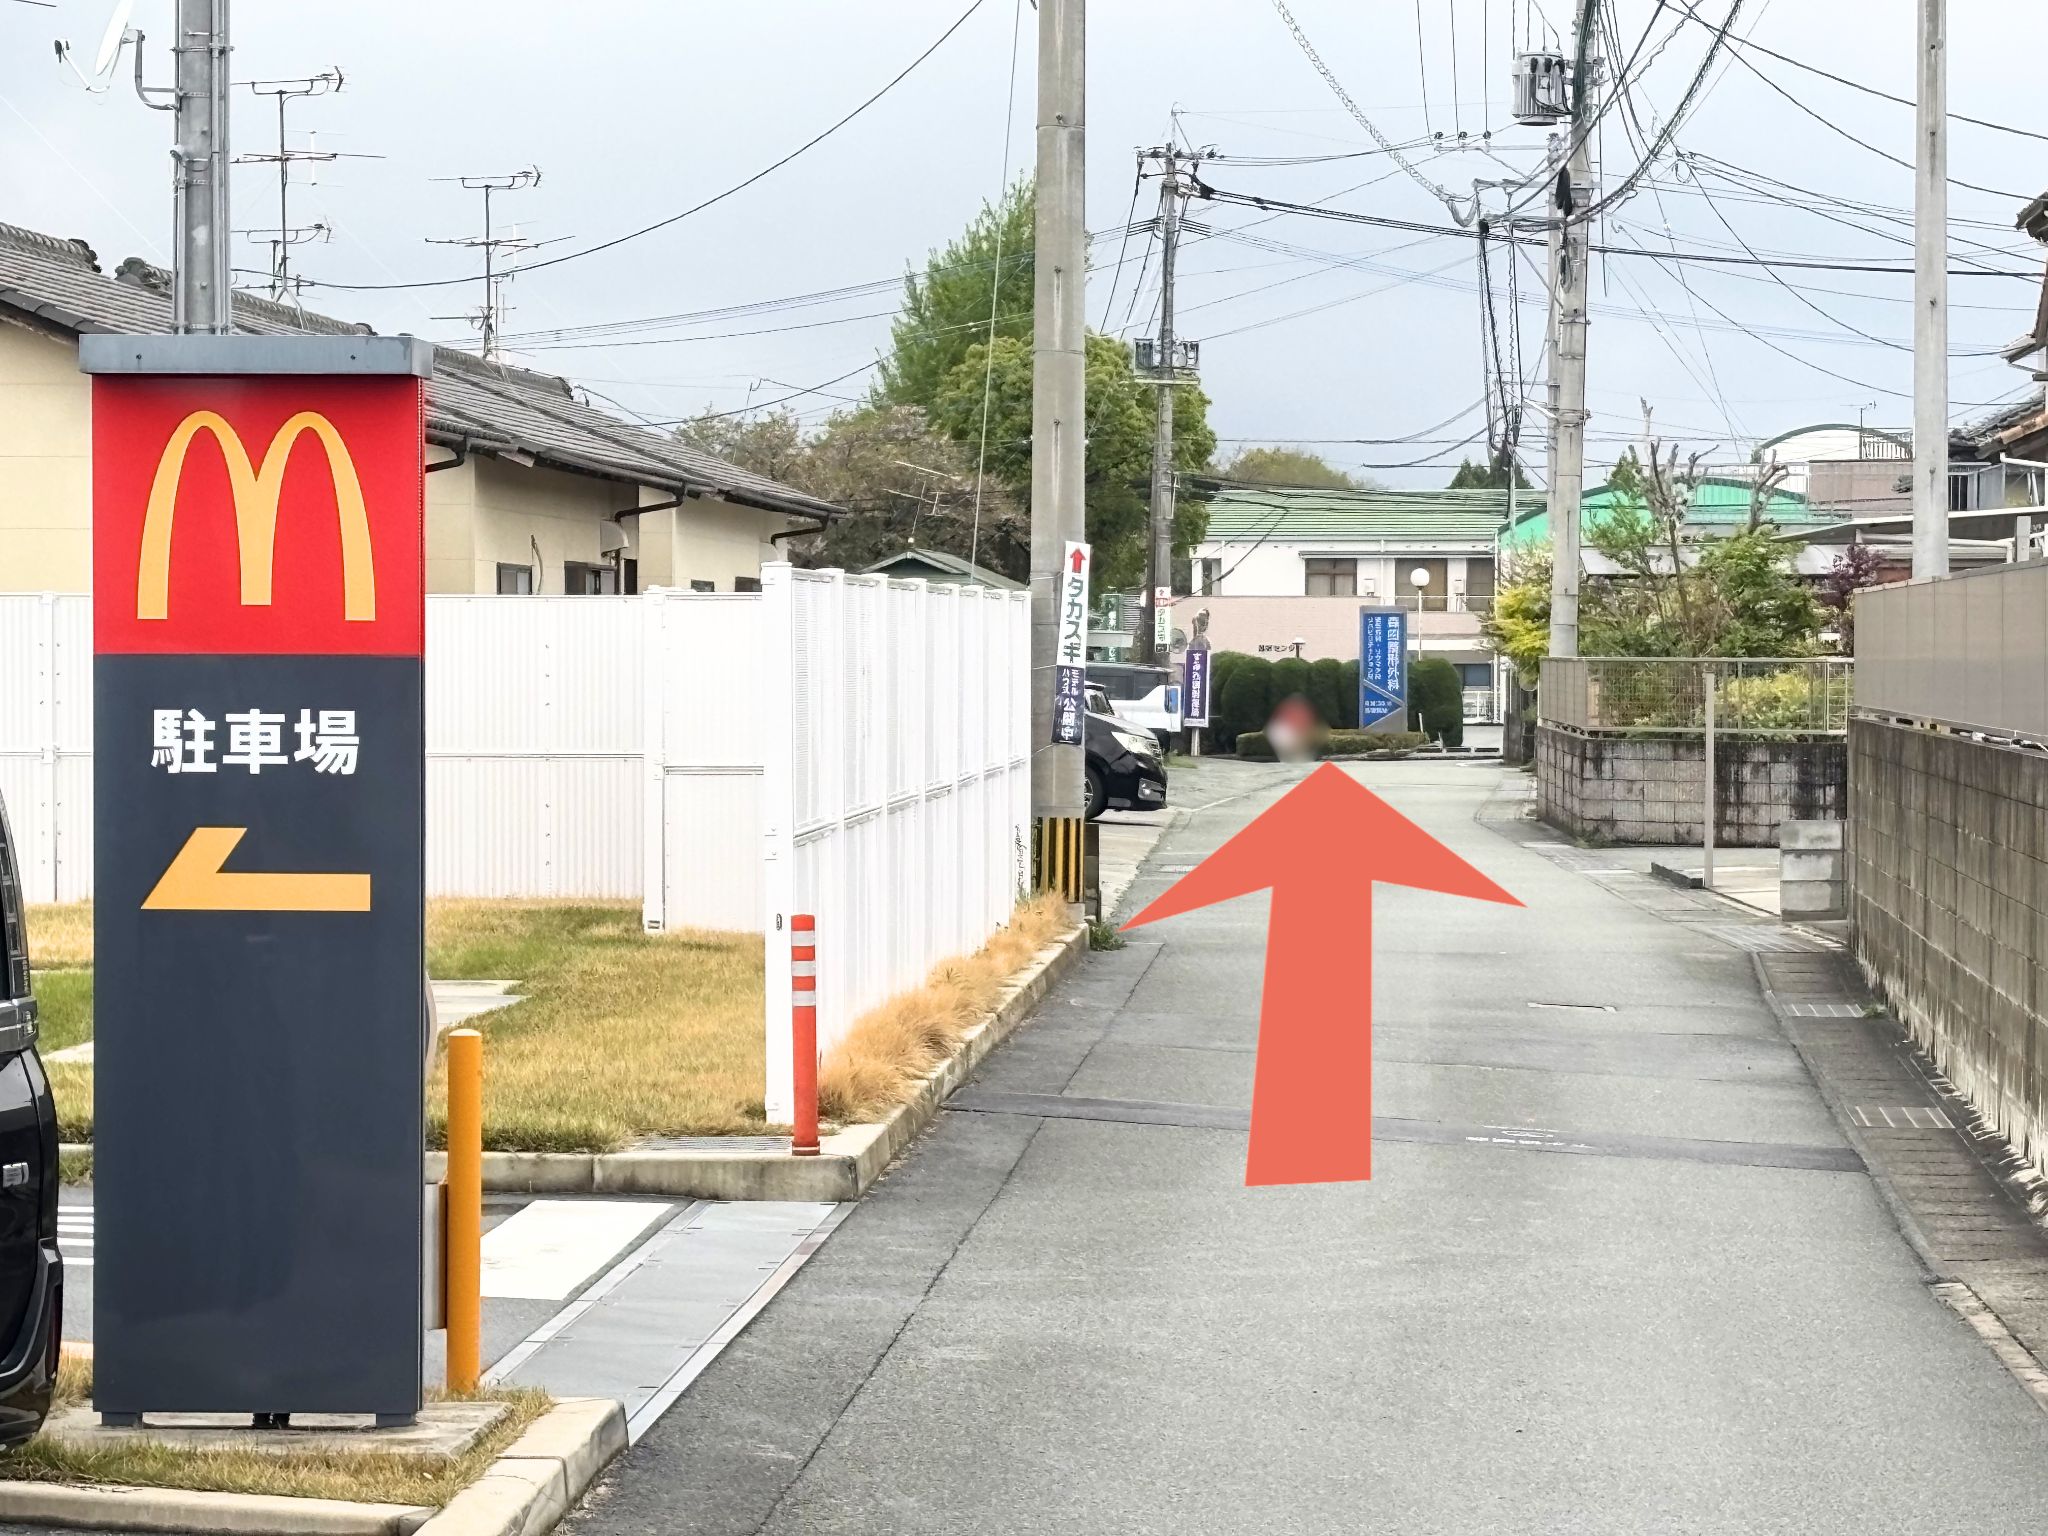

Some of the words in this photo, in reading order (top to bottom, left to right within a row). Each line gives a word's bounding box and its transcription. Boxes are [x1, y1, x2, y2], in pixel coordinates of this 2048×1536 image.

[1062, 576, 1084, 664] タカスギ
[151, 708, 361, 775] 駐車場
[1060, 697, 1077, 741] 公開中
